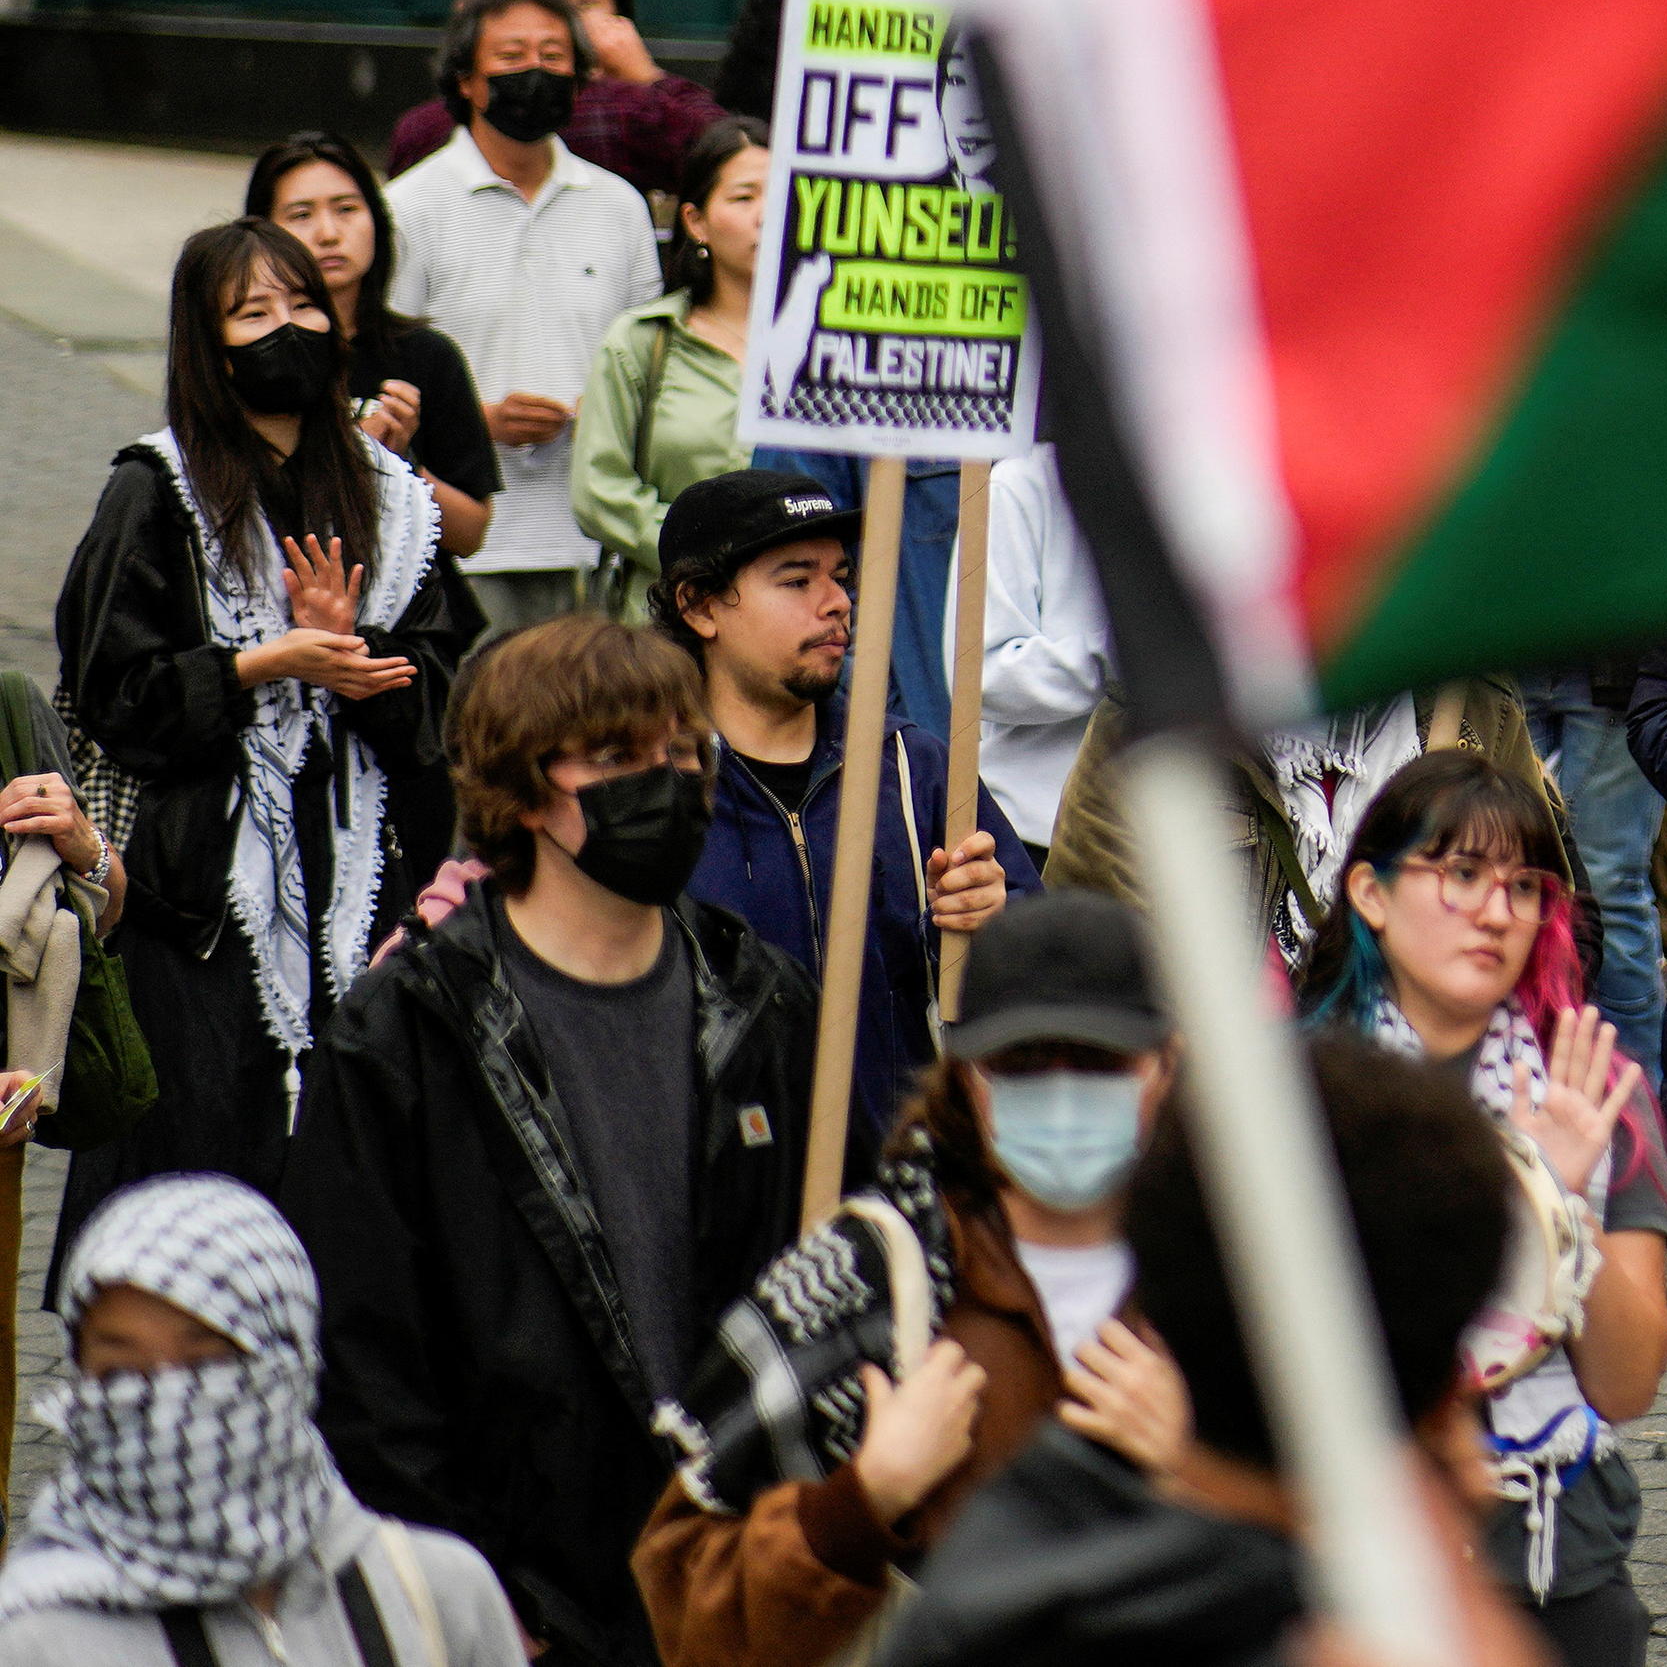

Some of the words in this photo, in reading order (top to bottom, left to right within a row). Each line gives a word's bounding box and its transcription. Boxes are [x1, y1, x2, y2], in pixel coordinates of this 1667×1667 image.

[809, 2, 936, 57] HANDS
[797, 68, 936, 160] OFF
[795, 174, 1018, 263] YUNSEO!
[844, 275, 950, 321] HANDS
[960, 283, 1018, 324] OFF
[811, 333, 1011, 393] PALESTINE!
[784, 496, 833, 518] Supreme
